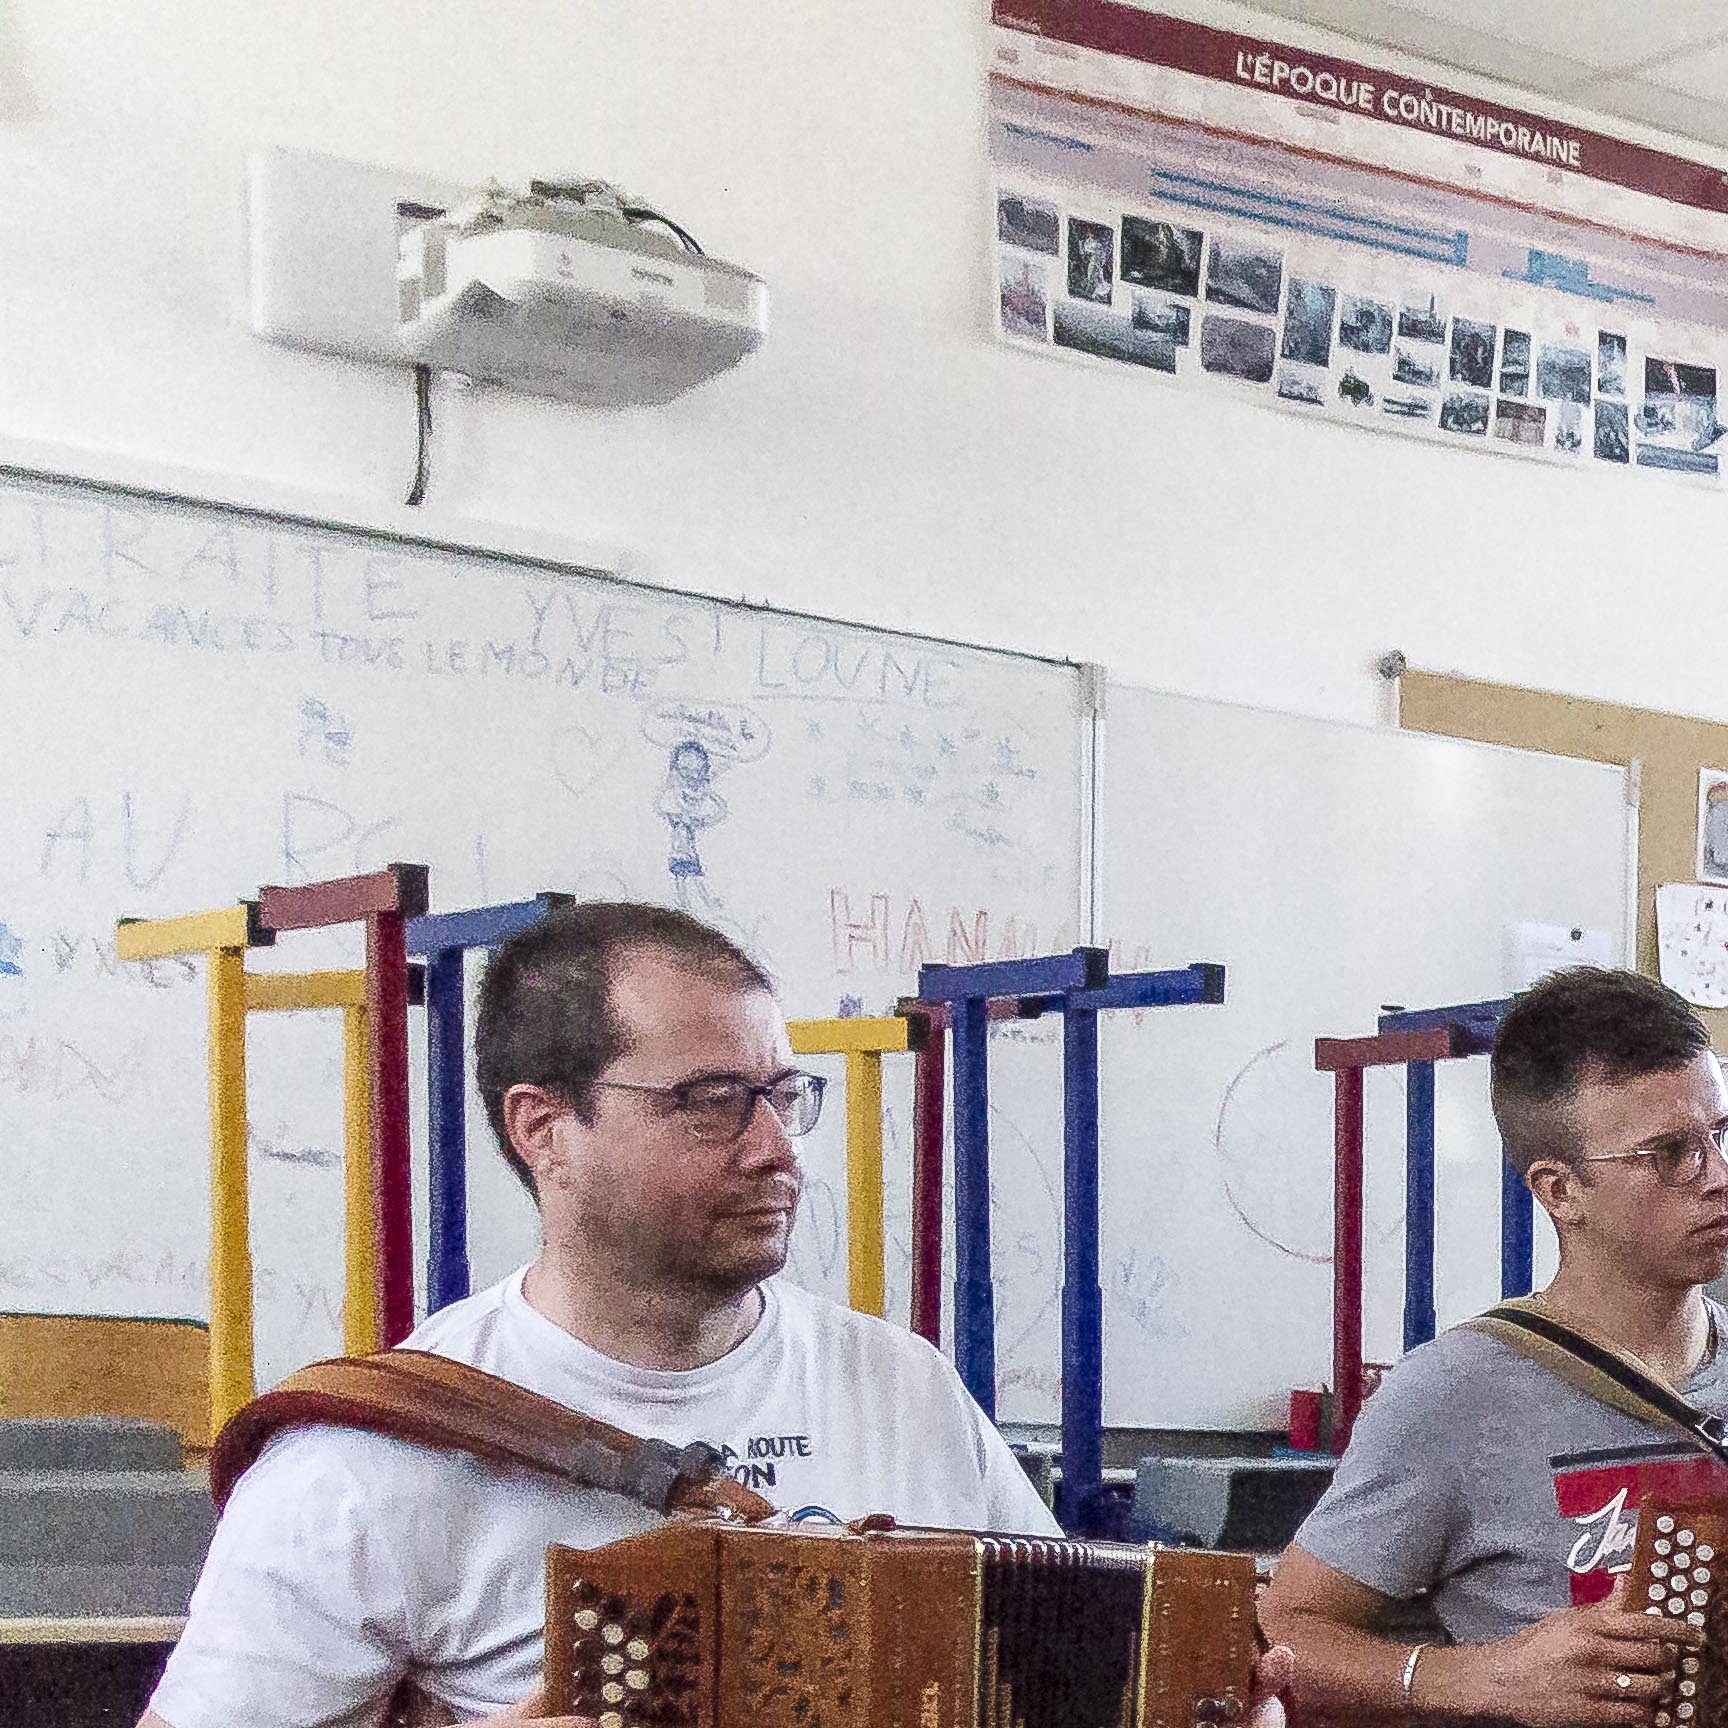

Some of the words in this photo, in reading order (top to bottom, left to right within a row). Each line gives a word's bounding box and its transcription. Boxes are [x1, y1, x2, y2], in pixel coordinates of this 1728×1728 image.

[1235, 50, 1375, 113] L'ÉPOQUE
[1381, 90, 1583, 168] CONTEMPORAINE
[0, 502, 418, 621] TRAITE
